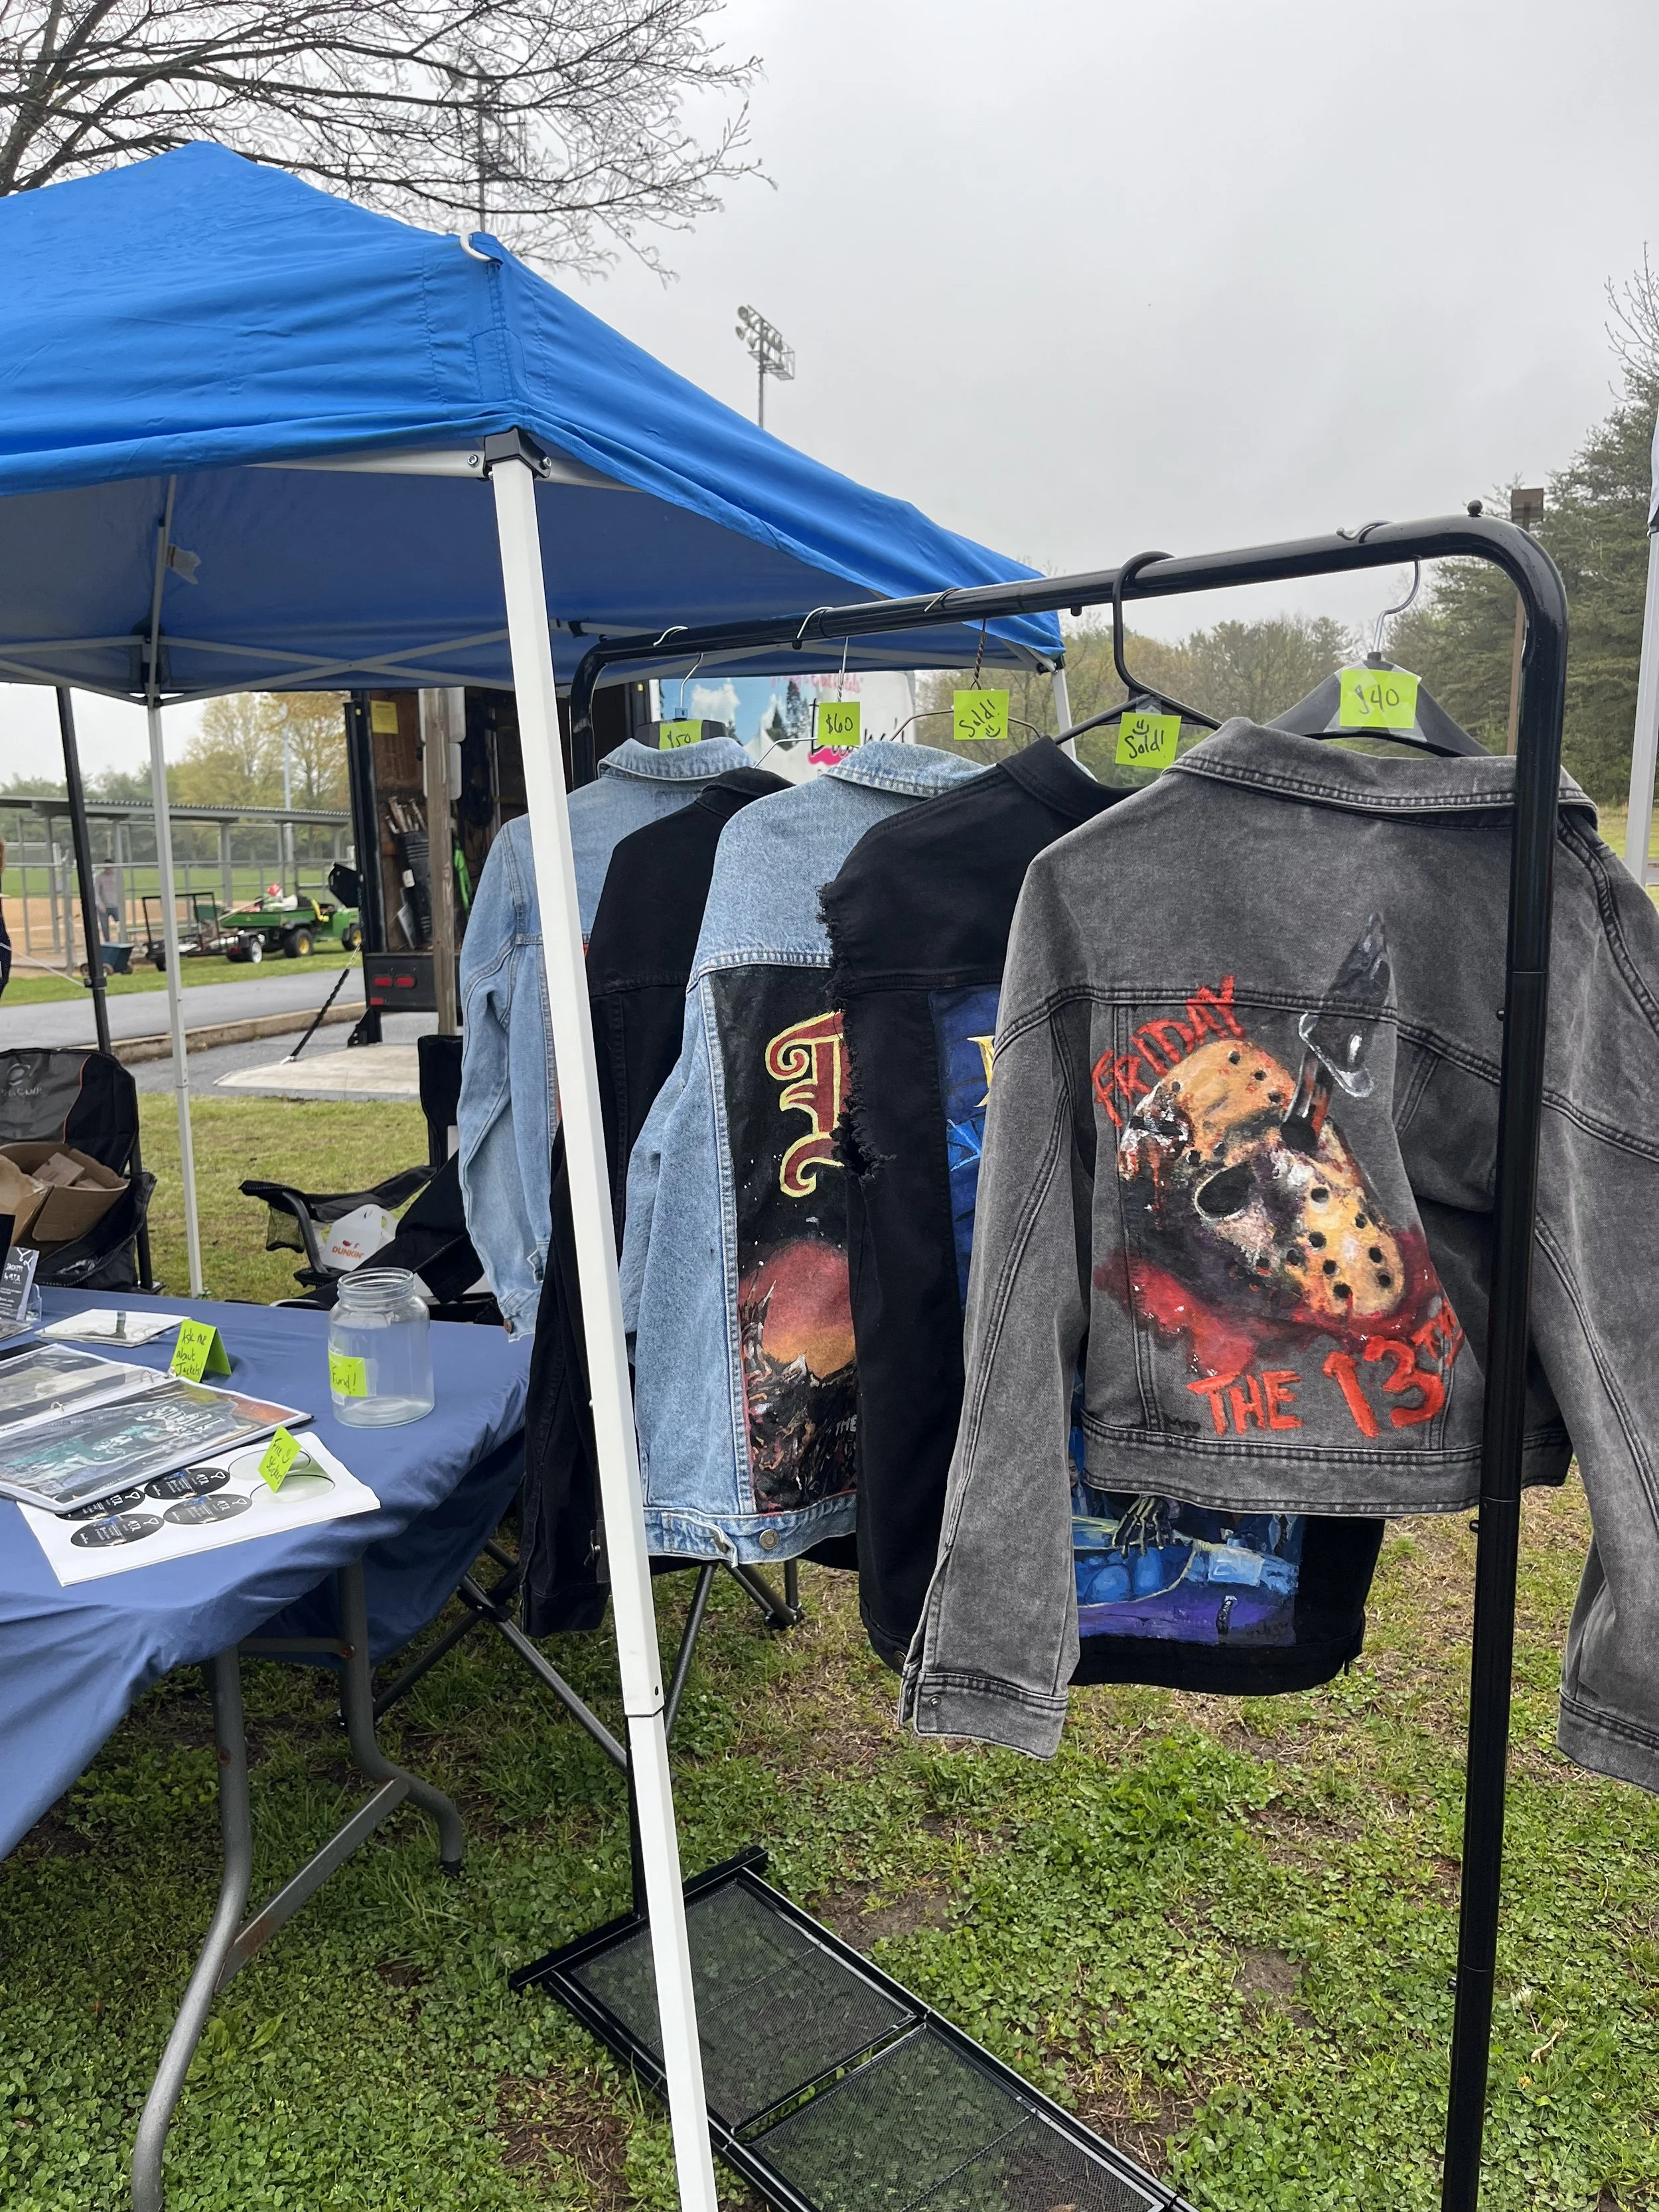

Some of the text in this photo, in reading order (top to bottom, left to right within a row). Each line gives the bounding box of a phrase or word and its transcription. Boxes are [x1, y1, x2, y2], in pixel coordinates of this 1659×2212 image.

[1354, 684, 1400, 715] $40
[826, 713, 853, 734] $60
[959, 698, 1000, 738] Sold!
[1124, 728, 1166, 759] Sold!
[1092, 975, 1246, 1128] FRIDAY
[181, 1328, 195, 1345] Ask
[176, 1347, 196, 1362] about
[1187, 1369, 1303, 1436] THE
